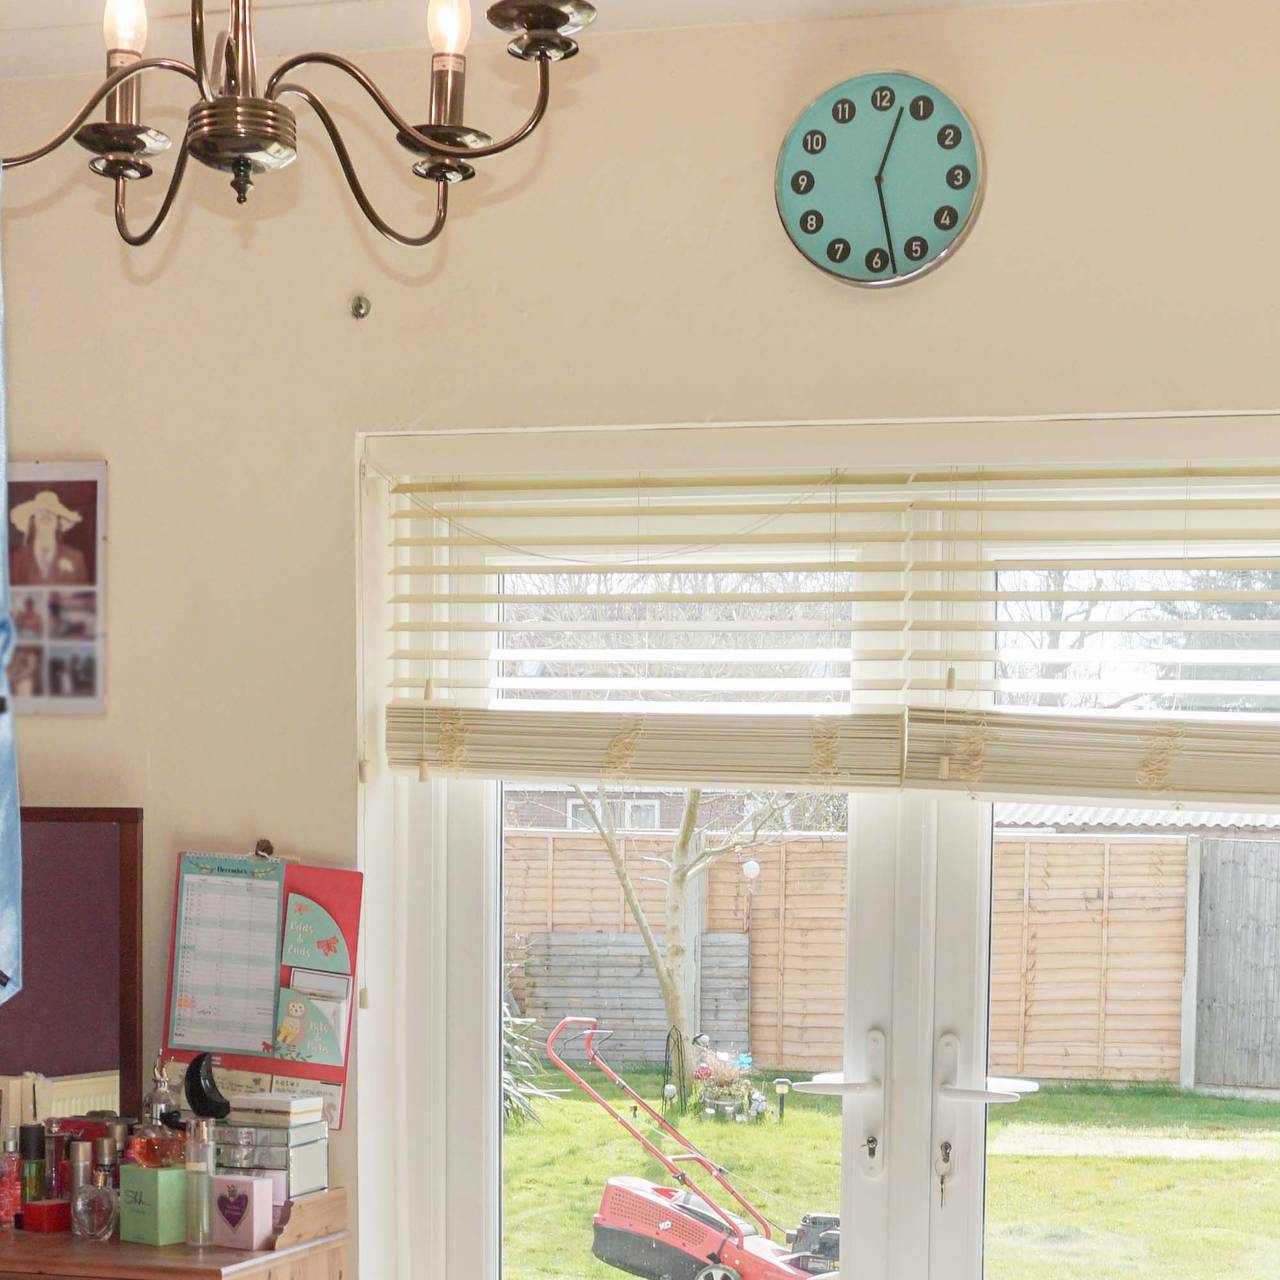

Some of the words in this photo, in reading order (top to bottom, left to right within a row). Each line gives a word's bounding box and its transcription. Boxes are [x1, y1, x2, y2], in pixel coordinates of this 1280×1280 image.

[874, 91, 890, 107] 12
[837, 104, 849, 119] 11
[805, 134, 822, 150] 10
[944, 129, 954, 145] 2
[798, 175, 807, 191] 9
[953, 169, 963, 185] 3
[807, 214, 816, 230] 8
[940, 211, 950, 225] 4
[834, 243, 844, 258] 7
[912, 241, 921, 256] 5
[872, 253, 881, 268] 6
